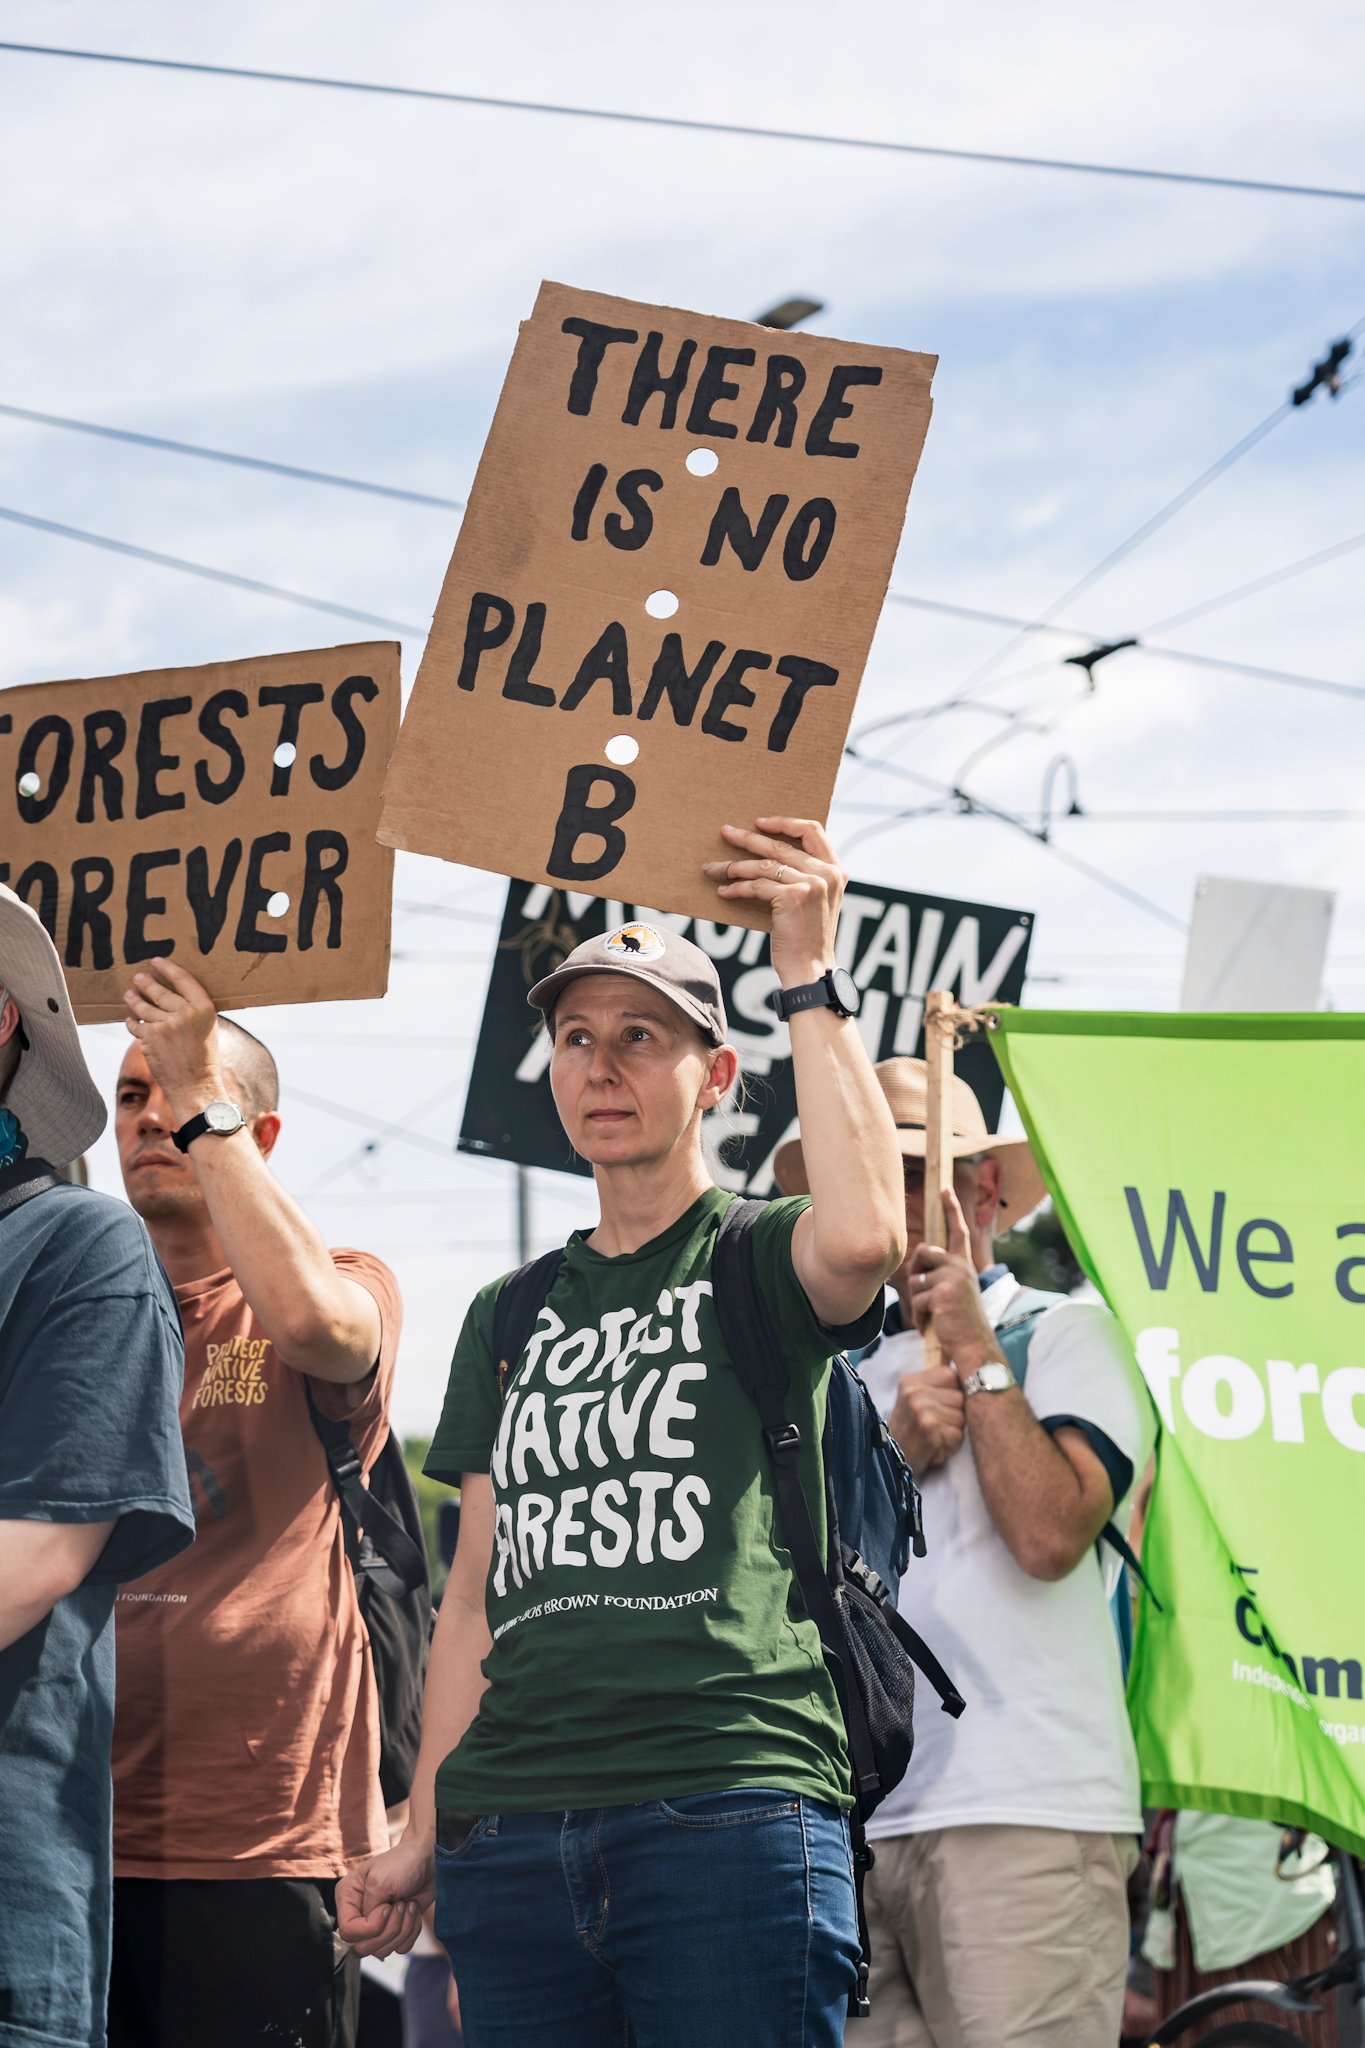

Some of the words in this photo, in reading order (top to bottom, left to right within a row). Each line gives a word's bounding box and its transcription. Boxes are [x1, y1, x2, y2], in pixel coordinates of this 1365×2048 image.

[561, 317, 883, 459] THERE
[571, 463, 664, 551] IS
[700, 487, 837, 581] NO
[457, 592, 840, 753] PLANET
[0, 676, 379, 824] ORESTS
[546, 764, 636, 881] B
[0, 829, 348, 970] OREVER
[1124, 1186, 1294, 1299] We
[192, 1380, 268, 1410] FORESTS
[121, 1592, 188, 1604] FOUNDATION
[544, 1594, 600, 1615] BROWN
[603, 1587, 718, 1610] FOUNDATION
